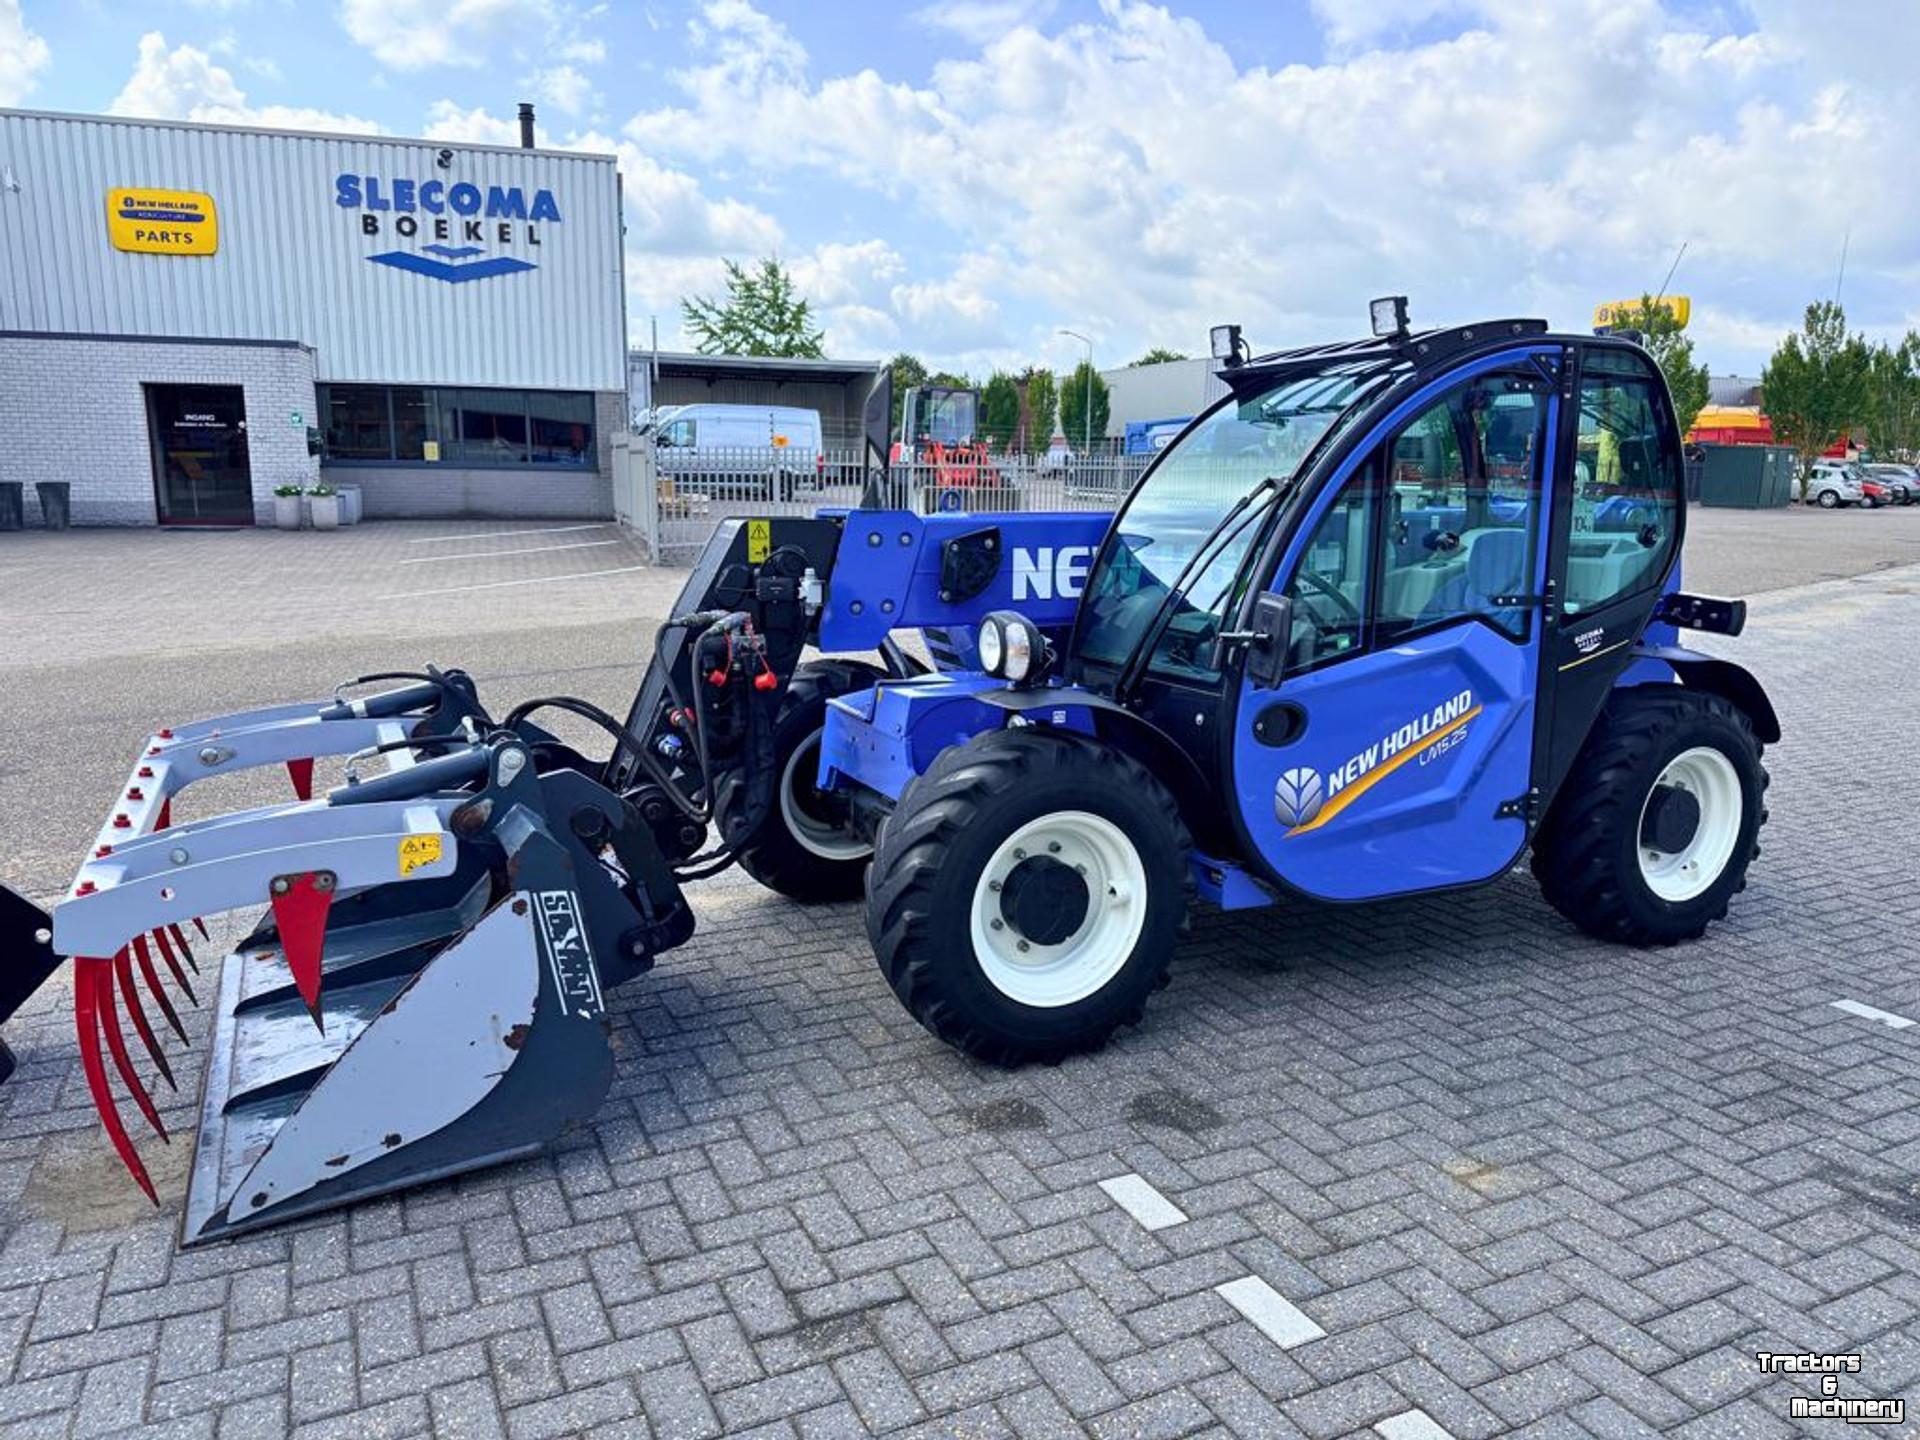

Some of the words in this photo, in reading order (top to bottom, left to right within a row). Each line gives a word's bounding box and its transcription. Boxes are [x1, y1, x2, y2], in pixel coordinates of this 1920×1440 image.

[335, 174, 562, 222] SLECOMA
[135, 230, 193, 244] PARTS
[362, 214, 541, 245] BOEKEL
[1012, 546, 1099, 600] NE
[1328, 743, 1379, 797] NEW
[1381, 689, 1472, 761] HOLLAND
